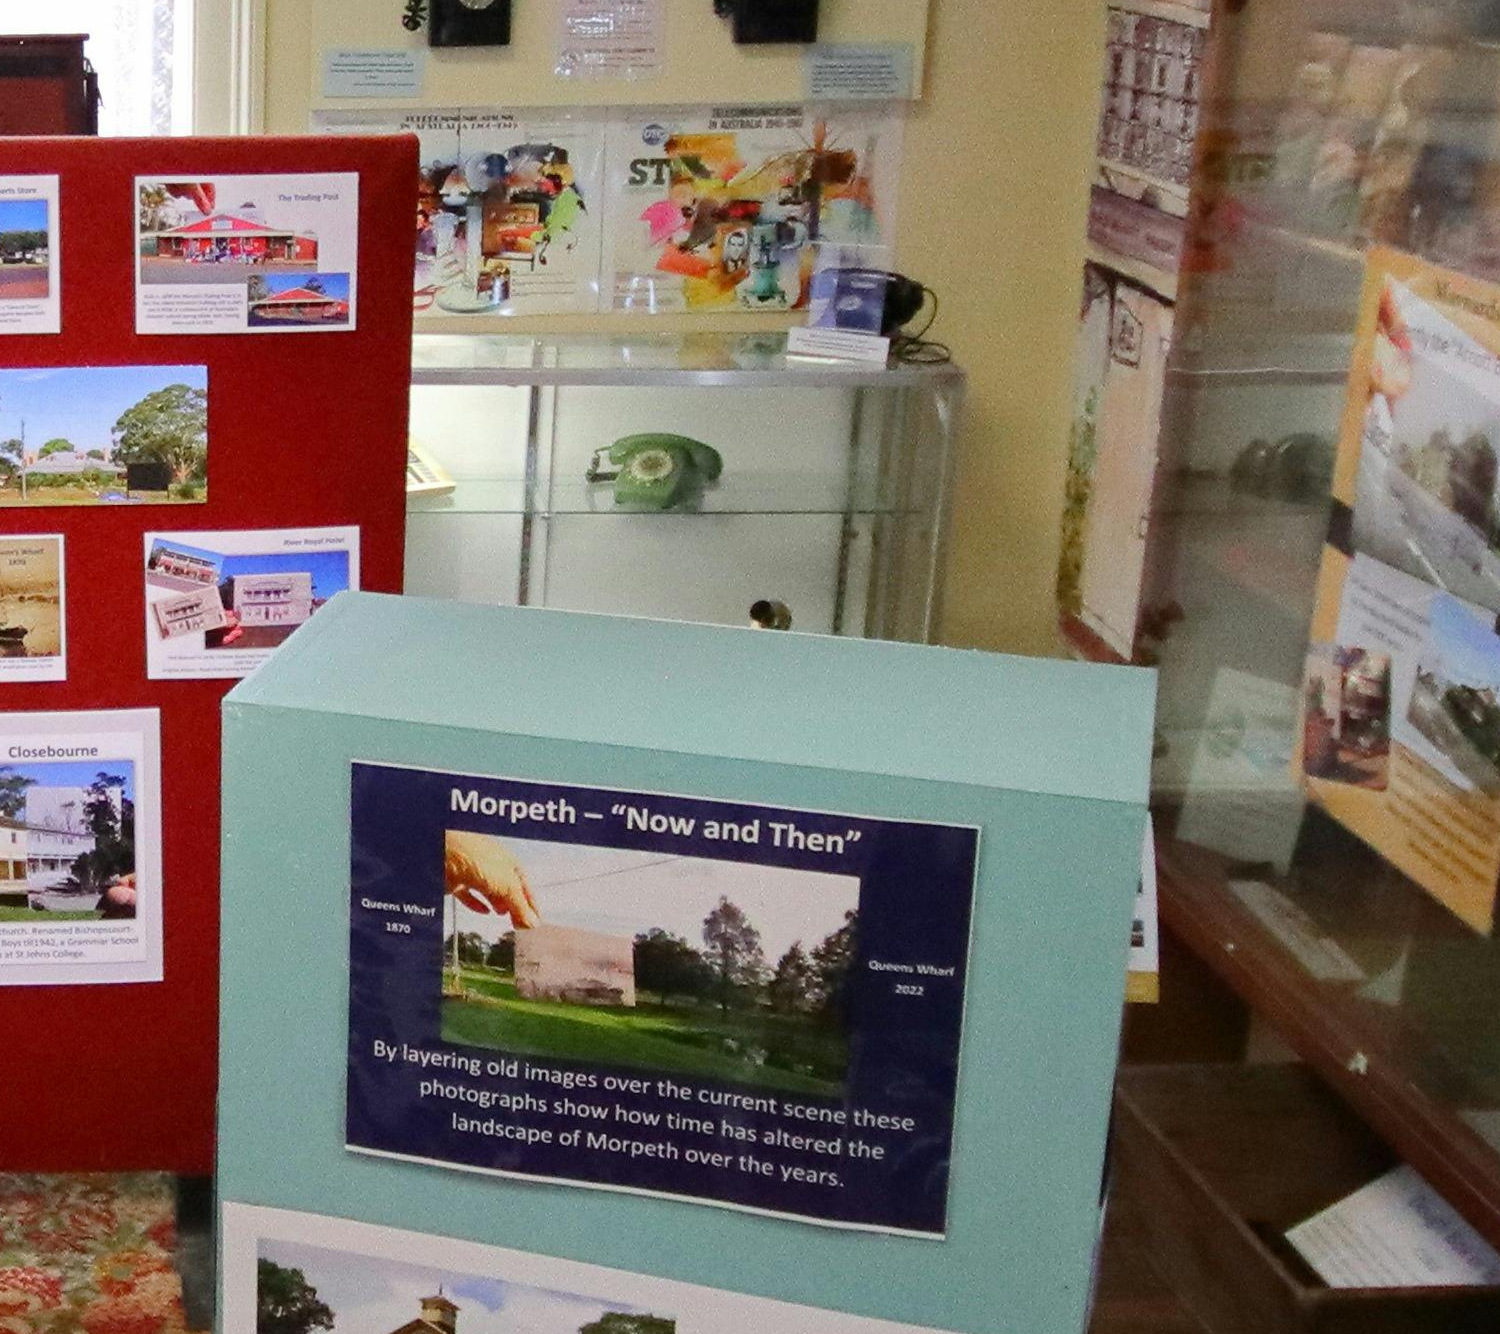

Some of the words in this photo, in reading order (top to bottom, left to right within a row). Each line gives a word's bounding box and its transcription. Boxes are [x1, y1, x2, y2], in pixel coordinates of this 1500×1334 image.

[7, 745, 98, 758] Closebourne
[450, 788, 575, 823] Morpeth
[702, 818, 759, 843] and
[360, 897, 400, 911] Queens
[402, 903, 435, 916] Wharf
[386, 921, 411, 933] 1870
[868, 959, 914, 973] Queens
[916, 964, 954, 976] Wharf
[894, 983, 924, 995] 2022
[373, 1039, 397, 1062] By
[402, 1043, 481, 1076] layering
[486, 1058, 518, 1078] old
[524, 1062, 597, 1089] images
[603, 1076, 650, 1093] over
[656, 1079, 691, 1100] the
[697, 1089, 777, 1114] current
[783, 1103, 846, 1124] scene
[853, 1108, 915, 1131] these
[419, 1078, 547, 1112] photographs
[553, 1097, 608, 1119] show
[614, 1103, 660, 1126] how
[666, 1112, 714, 1134] time
[720, 1118, 757, 1142] has
[762, 1128, 841, 1154] altered
[847, 1139, 884, 1159] the
[451, 1112, 552, 1144] landscape
[558, 1129, 581, 1146] of
[586, 1131, 678, 1159] Morpeth
[684, 1149, 733, 1167] over
[738, 1154, 773, 1175] the
[780, 1164, 843, 1186] years.
